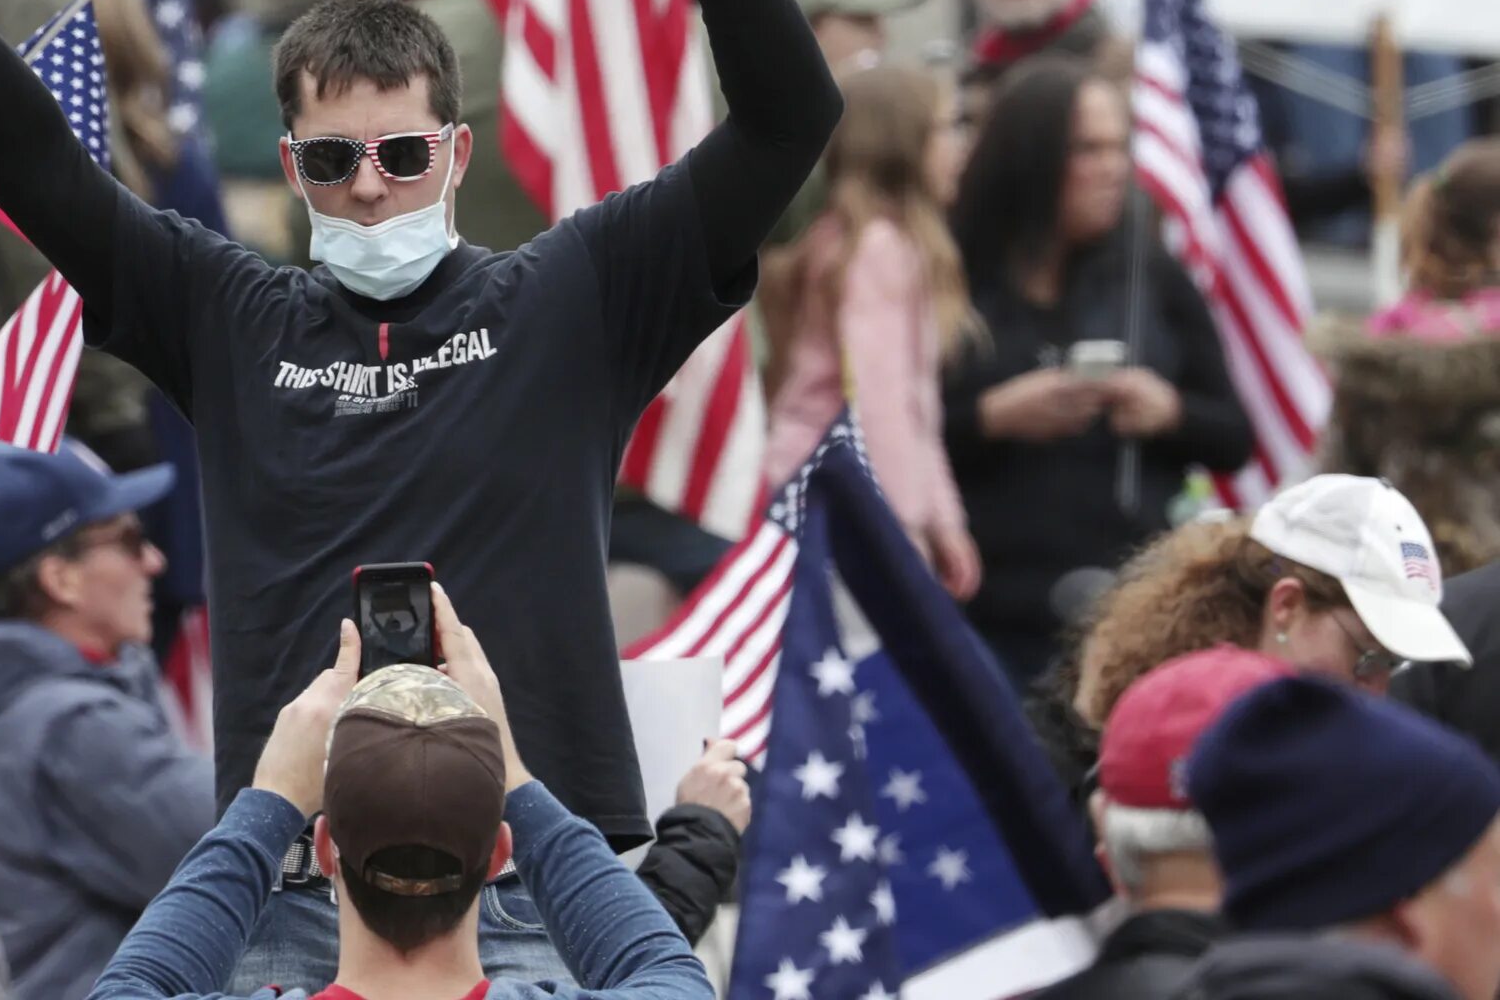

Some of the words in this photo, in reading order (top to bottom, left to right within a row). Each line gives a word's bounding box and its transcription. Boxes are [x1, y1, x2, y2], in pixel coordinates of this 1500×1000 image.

[274, 360, 323, 389] THIS
[319, 361, 382, 397] SHIRT
[387, 362, 408, 393] IS
